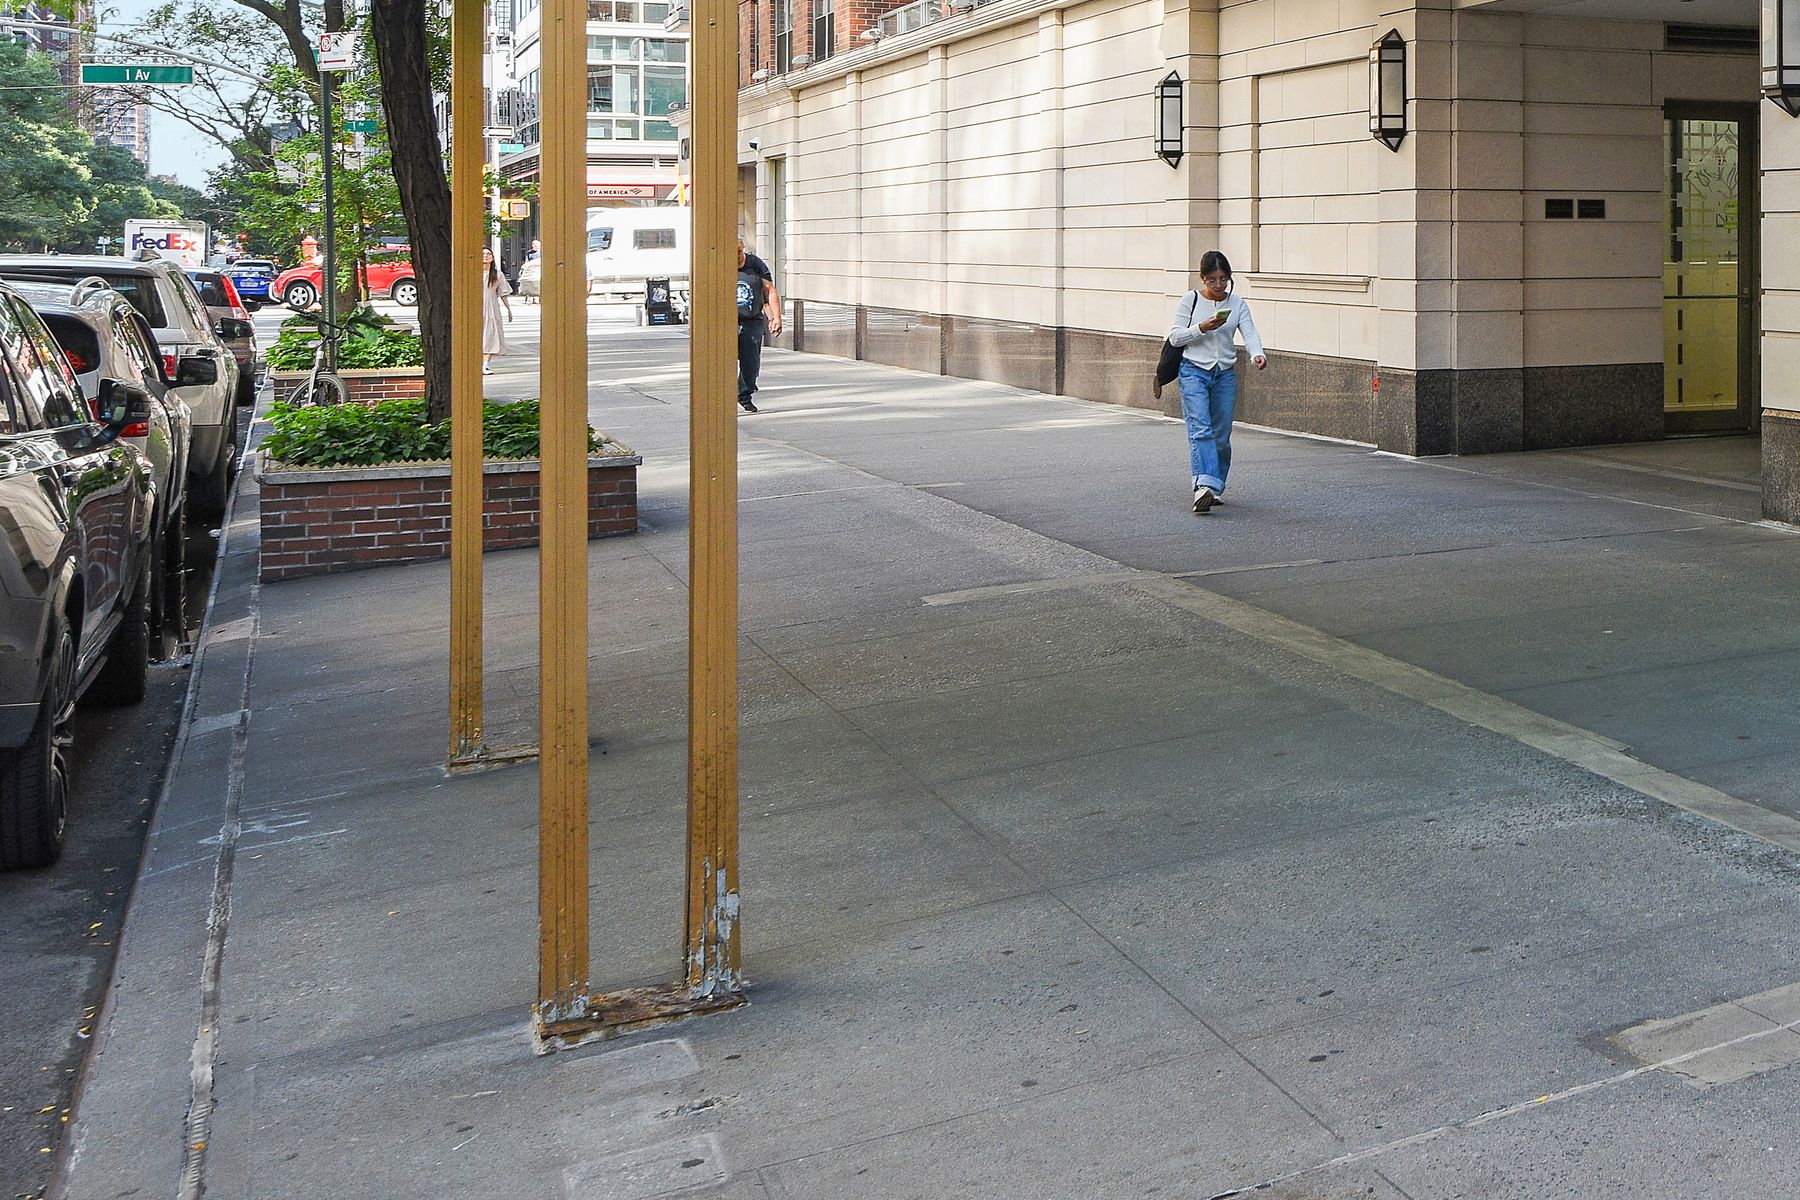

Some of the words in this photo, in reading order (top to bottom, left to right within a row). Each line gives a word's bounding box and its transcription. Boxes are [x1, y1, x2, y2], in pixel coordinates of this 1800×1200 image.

[125, 68, 130, 81] 1
[135, 68, 151, 81] Av
[131, 232, 197, 252] FedEx
